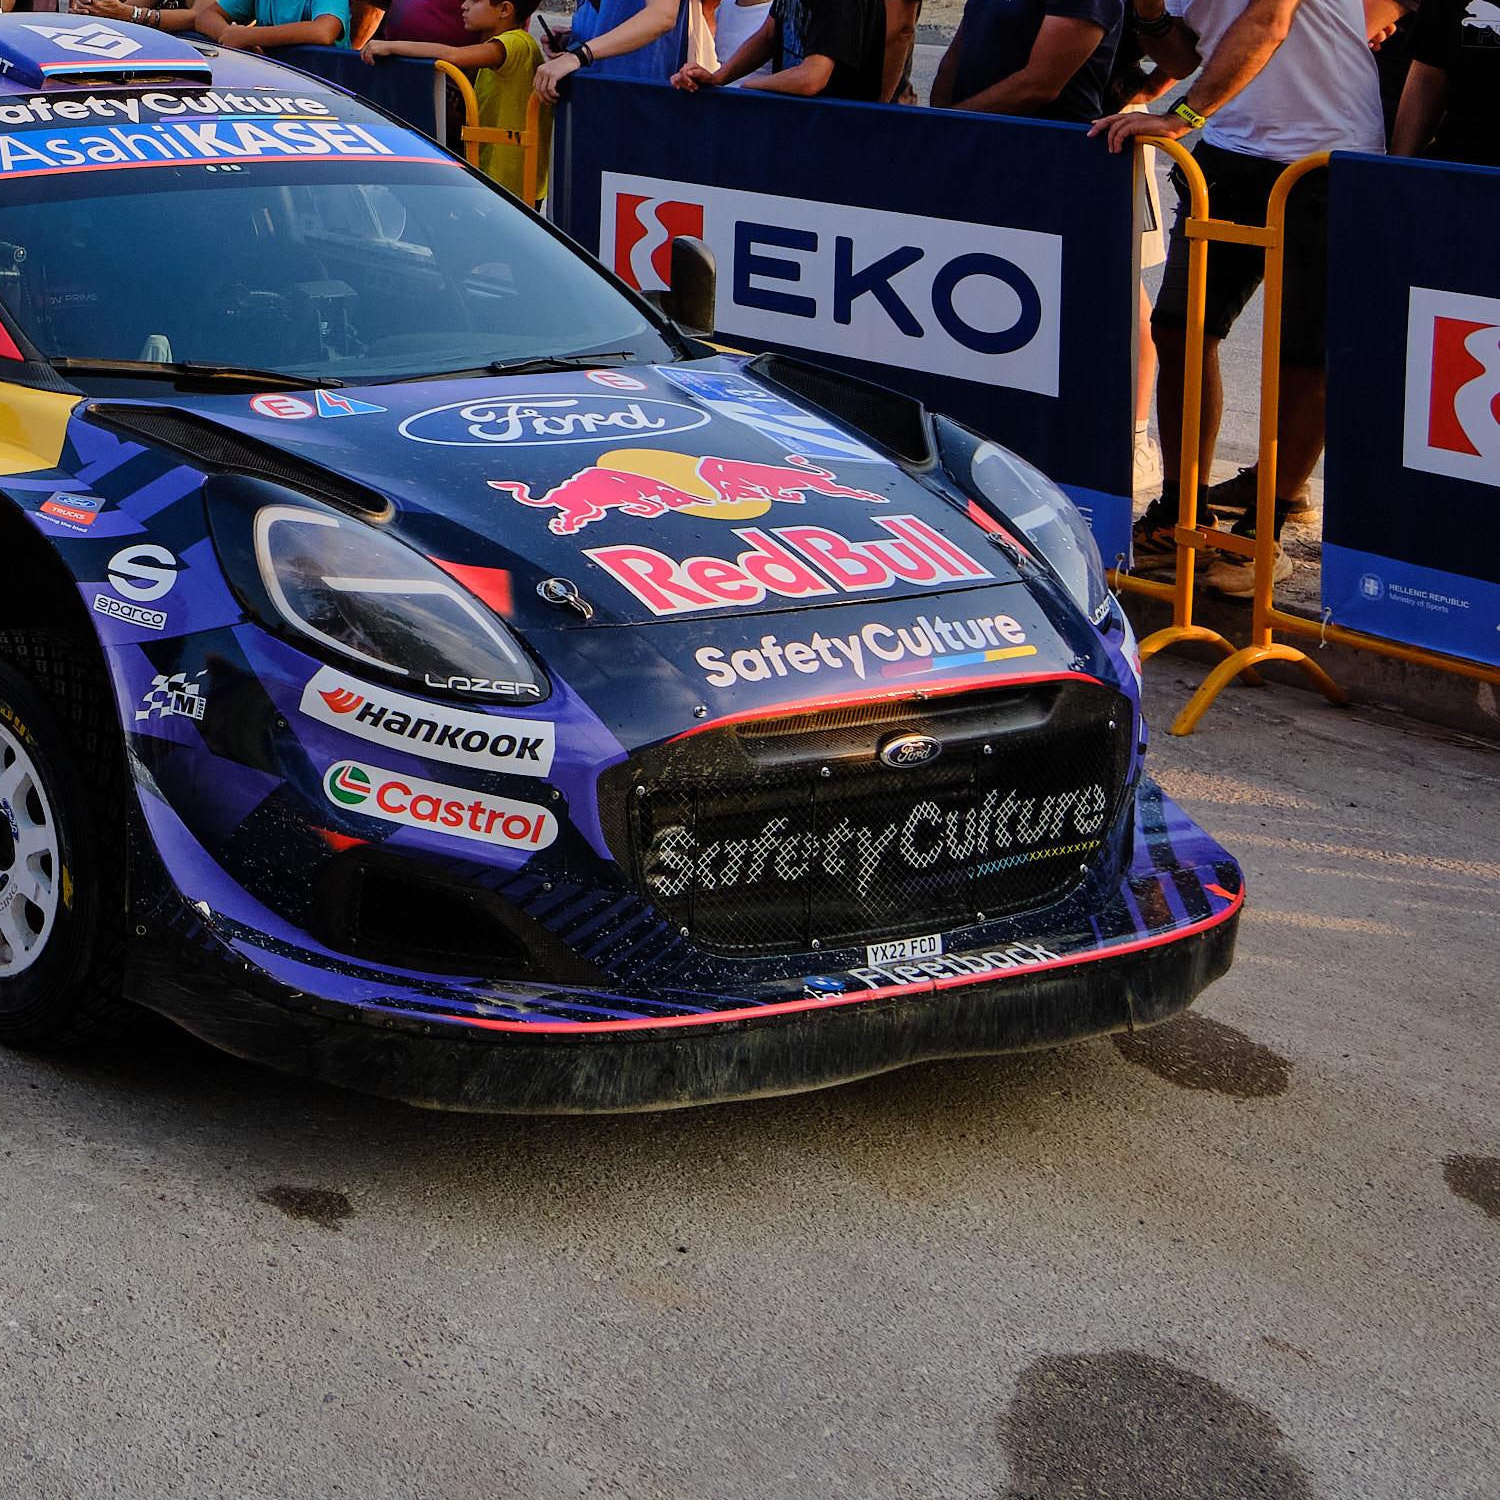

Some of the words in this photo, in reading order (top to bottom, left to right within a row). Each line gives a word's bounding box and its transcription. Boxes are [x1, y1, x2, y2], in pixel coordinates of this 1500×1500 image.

[733, 220, 1042, 355] EKO
[459, 399, 666, 442] Ford
[35, 511, 61, 525] Sharing
[60, 520, 72, 529] the
[71, 522, 88, 534] load
[52, 505, 86, 521] TRUCKS
[1388, 583, 1428, 599] HELLENIC
[1429, 592, 1470, 609] REPUBLIC
[1388, 593, 1416, 607] Ministry
[1417, 599, 1425, 608] of
[1425, 601, 1450, 614] Sports
[97, 596, 164, 626] sparco
[694, 612, 1027, 689] SafetyCulture
[424, 673, 541, 698] LAZER
[173, 694, 196, 716] M
[896, 738, 934, 764] Ford
[376, 779, 546, 845] Castrol
[653, 784, 1107, 898] SafetyCulture
[871, 942, 906, 963] YX22
[911, 936, 937, 956] FCD
[848, 941, 1064, 991] Fleetback
